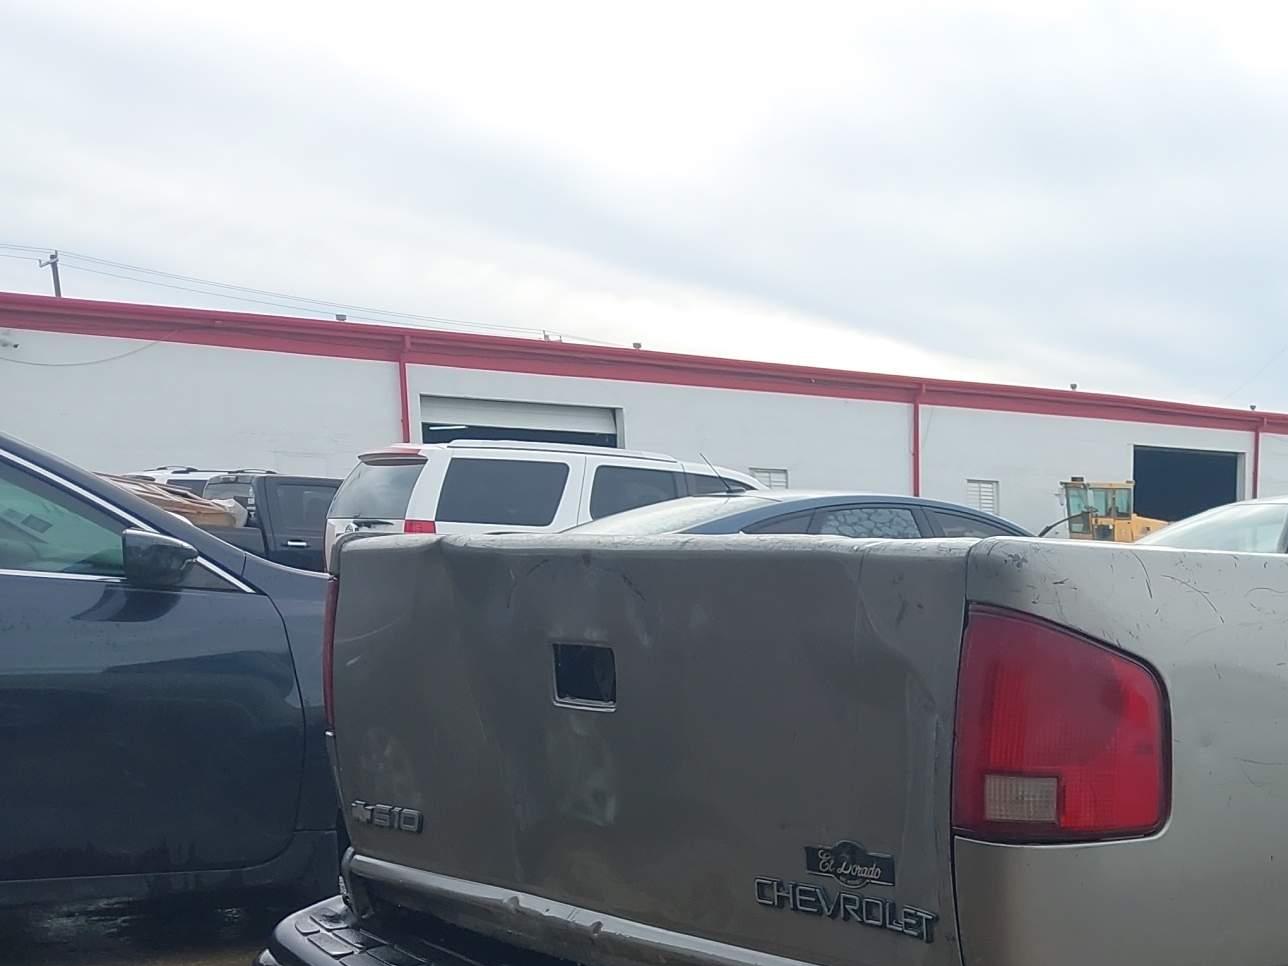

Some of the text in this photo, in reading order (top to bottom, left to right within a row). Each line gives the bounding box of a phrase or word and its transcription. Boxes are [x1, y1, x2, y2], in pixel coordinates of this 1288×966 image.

[817, 849, 881, 879] El Dorado
[754, 877, 937, 943] CHEVROLET
